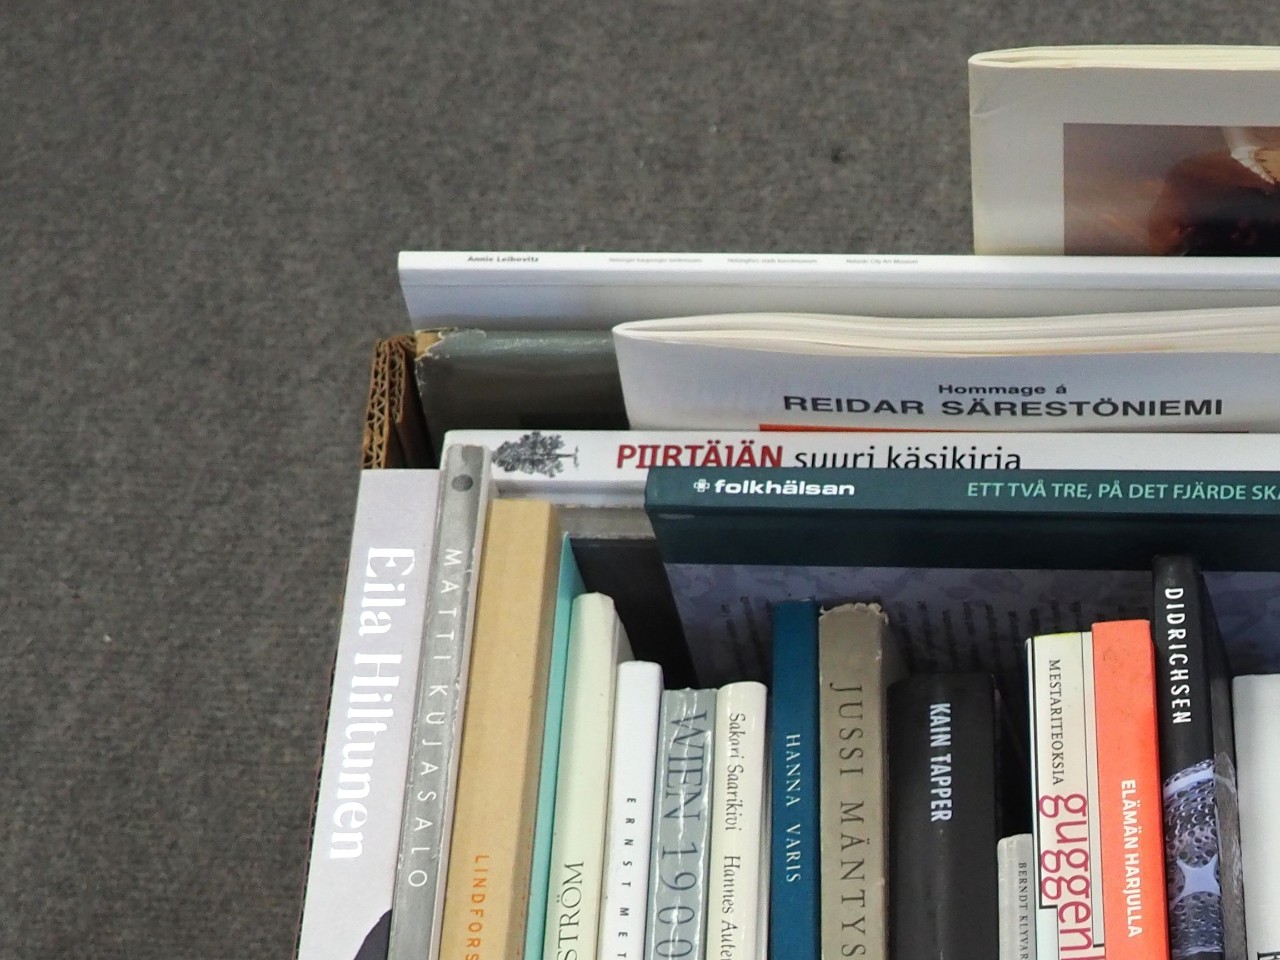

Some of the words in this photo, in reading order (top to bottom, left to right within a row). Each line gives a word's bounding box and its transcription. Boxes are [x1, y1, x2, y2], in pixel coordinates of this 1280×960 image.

[783, 396, 925, 415] REIDAR
[942, 397, 1222, 417] SÄRESTÖNIEMI
[938, 384, 1046, 397] Hommage
[714, 478, 855, 497] folkhälsan
[795, 447, 875, 469] suuri
[968, 482, 1005, 497] ETT
[1008, 480, 1046, 497] TVÅ
[1051, 482, 1093, 499] TRE,
[1098, 481, 1124, 498] PÅ
[1129, 484, 1168, 498] DET
[1173, 482, 1247, 500] FJÄRDE
[358, 547, 415, 637] Eila
[433, 548, 463, 660] MATTI
[1164, 587, 1191, 724] DIDRICHSEN
[330, 653, 402, 859] Hiltunen
[727, 713, 746, 759] Sakari
[829, 683, 863, 776] JUSSI
[929, 702, 951, 747] KAIN
[1049, 658, 1064, 787] MESTARITEOKSIA
[408, 685, 448, 887] KUJASALO
[662, 711, 707, 821] WIEN
[725, 764, 745, 831] Saarikivi
[785, 734, 801, 807] HANNA
[931, 752, 952, 822] TAPPER
[621, 798, 636, 887] ERNST
[1120, 779, 1138, 849] ELÄMÄN
[722, 855, 741, 914] Hannes
[785, 823, 801, 883] VARIS
[1018, 862, 1029, 911] BERNDT
[655, 842, 698, 959] 1900
[1122, 853, 1143, 938] HARJULLA
